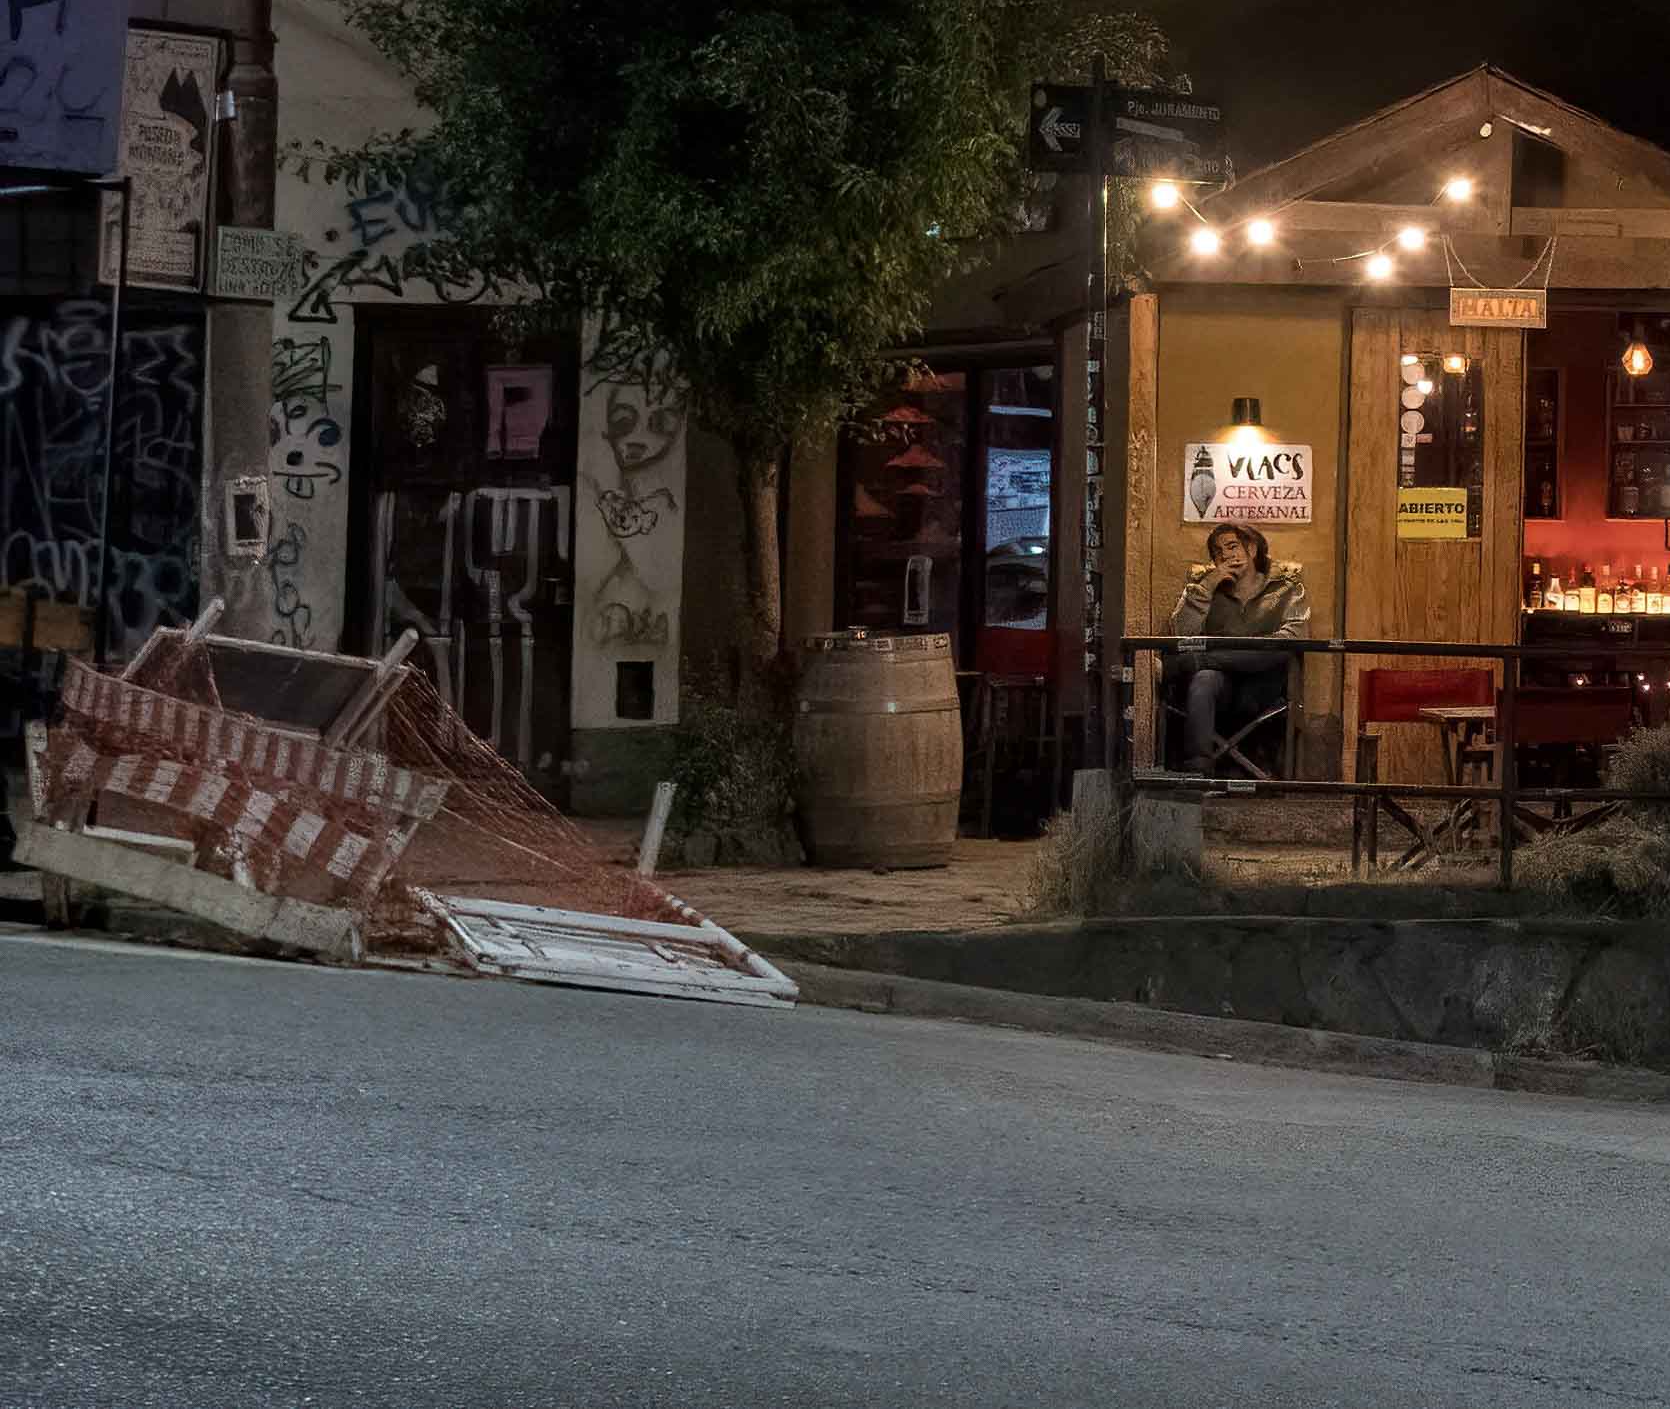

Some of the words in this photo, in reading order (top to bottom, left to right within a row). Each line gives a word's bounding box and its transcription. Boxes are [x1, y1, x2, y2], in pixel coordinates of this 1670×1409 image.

[1222, 485, 1307, 500] CERVEZA
[1213, 505, 1310, 520] ARTESANAL
[1398, 502, 1465, 514] ABIERTO
